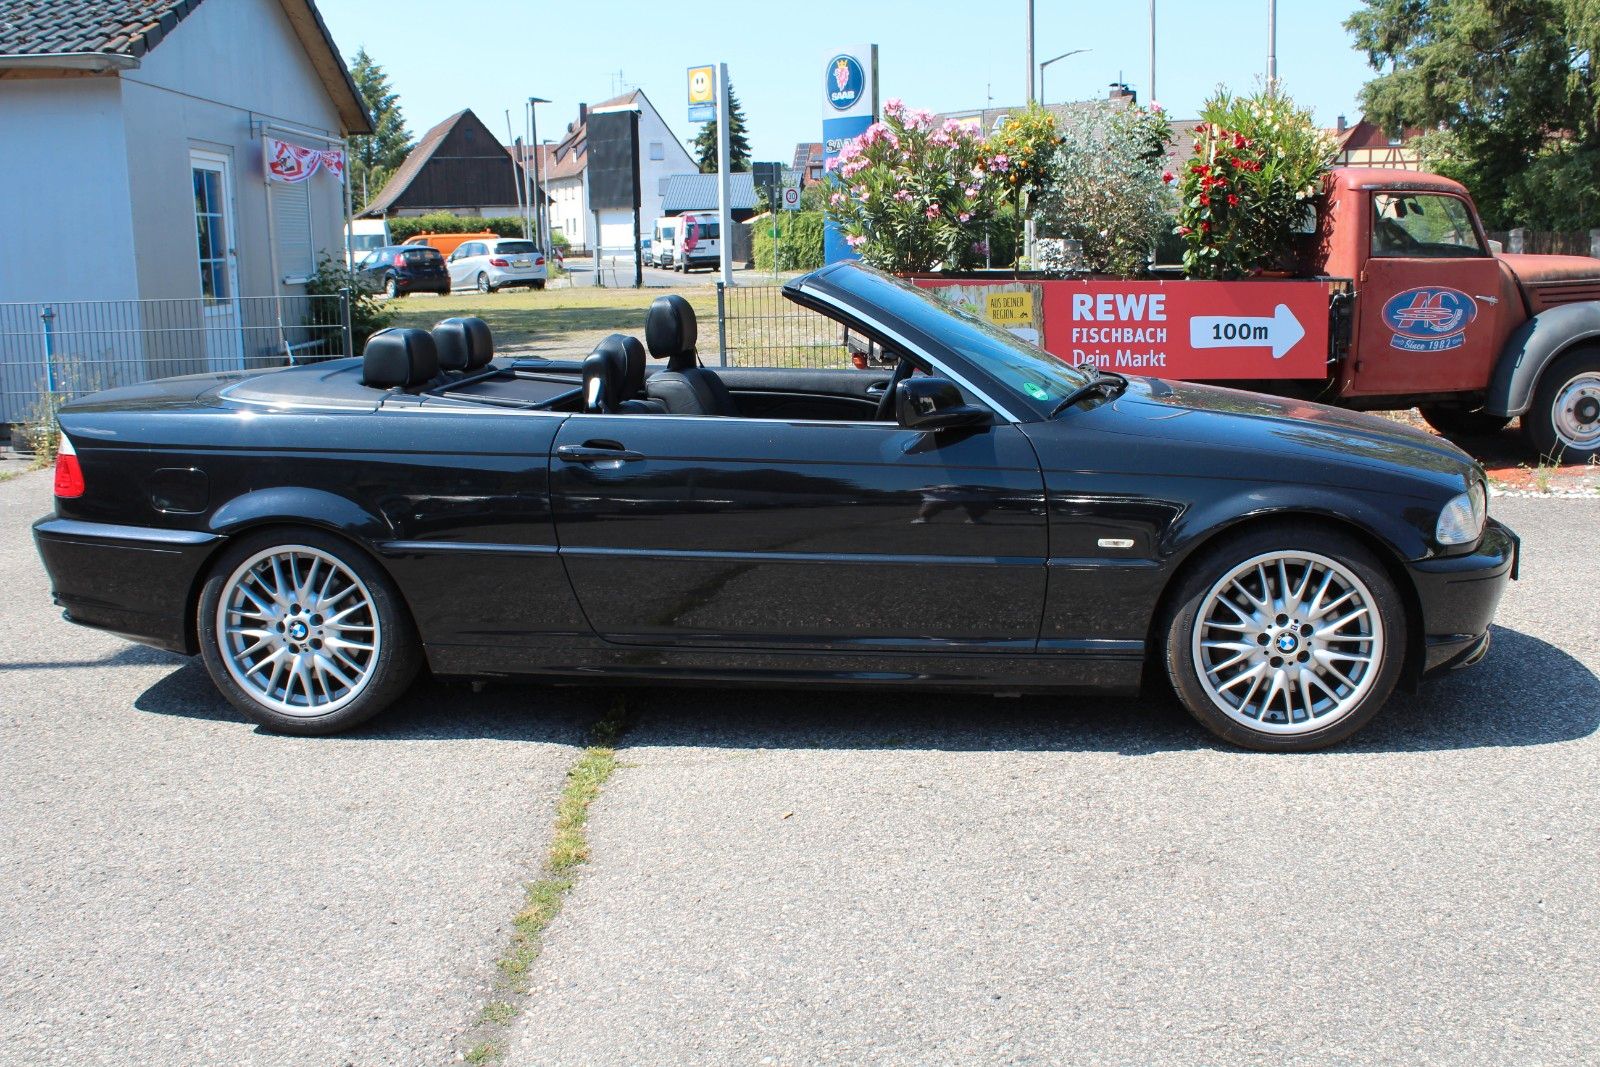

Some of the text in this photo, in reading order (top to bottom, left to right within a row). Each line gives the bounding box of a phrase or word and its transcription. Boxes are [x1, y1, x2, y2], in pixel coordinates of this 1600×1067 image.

[831, 90, 855, 101] SAAB
[990, 296, 1024, 309] AUS DEINER
[1072, 293, 1167, 322] REWE
[1072, 327, 1167, 343] FISCHBACH
[1212, 323, 1269, 340] 100m
[1404, 338, 1451, 351] Since 1982
[1072, 349, 1167, 368] Dein Markt
